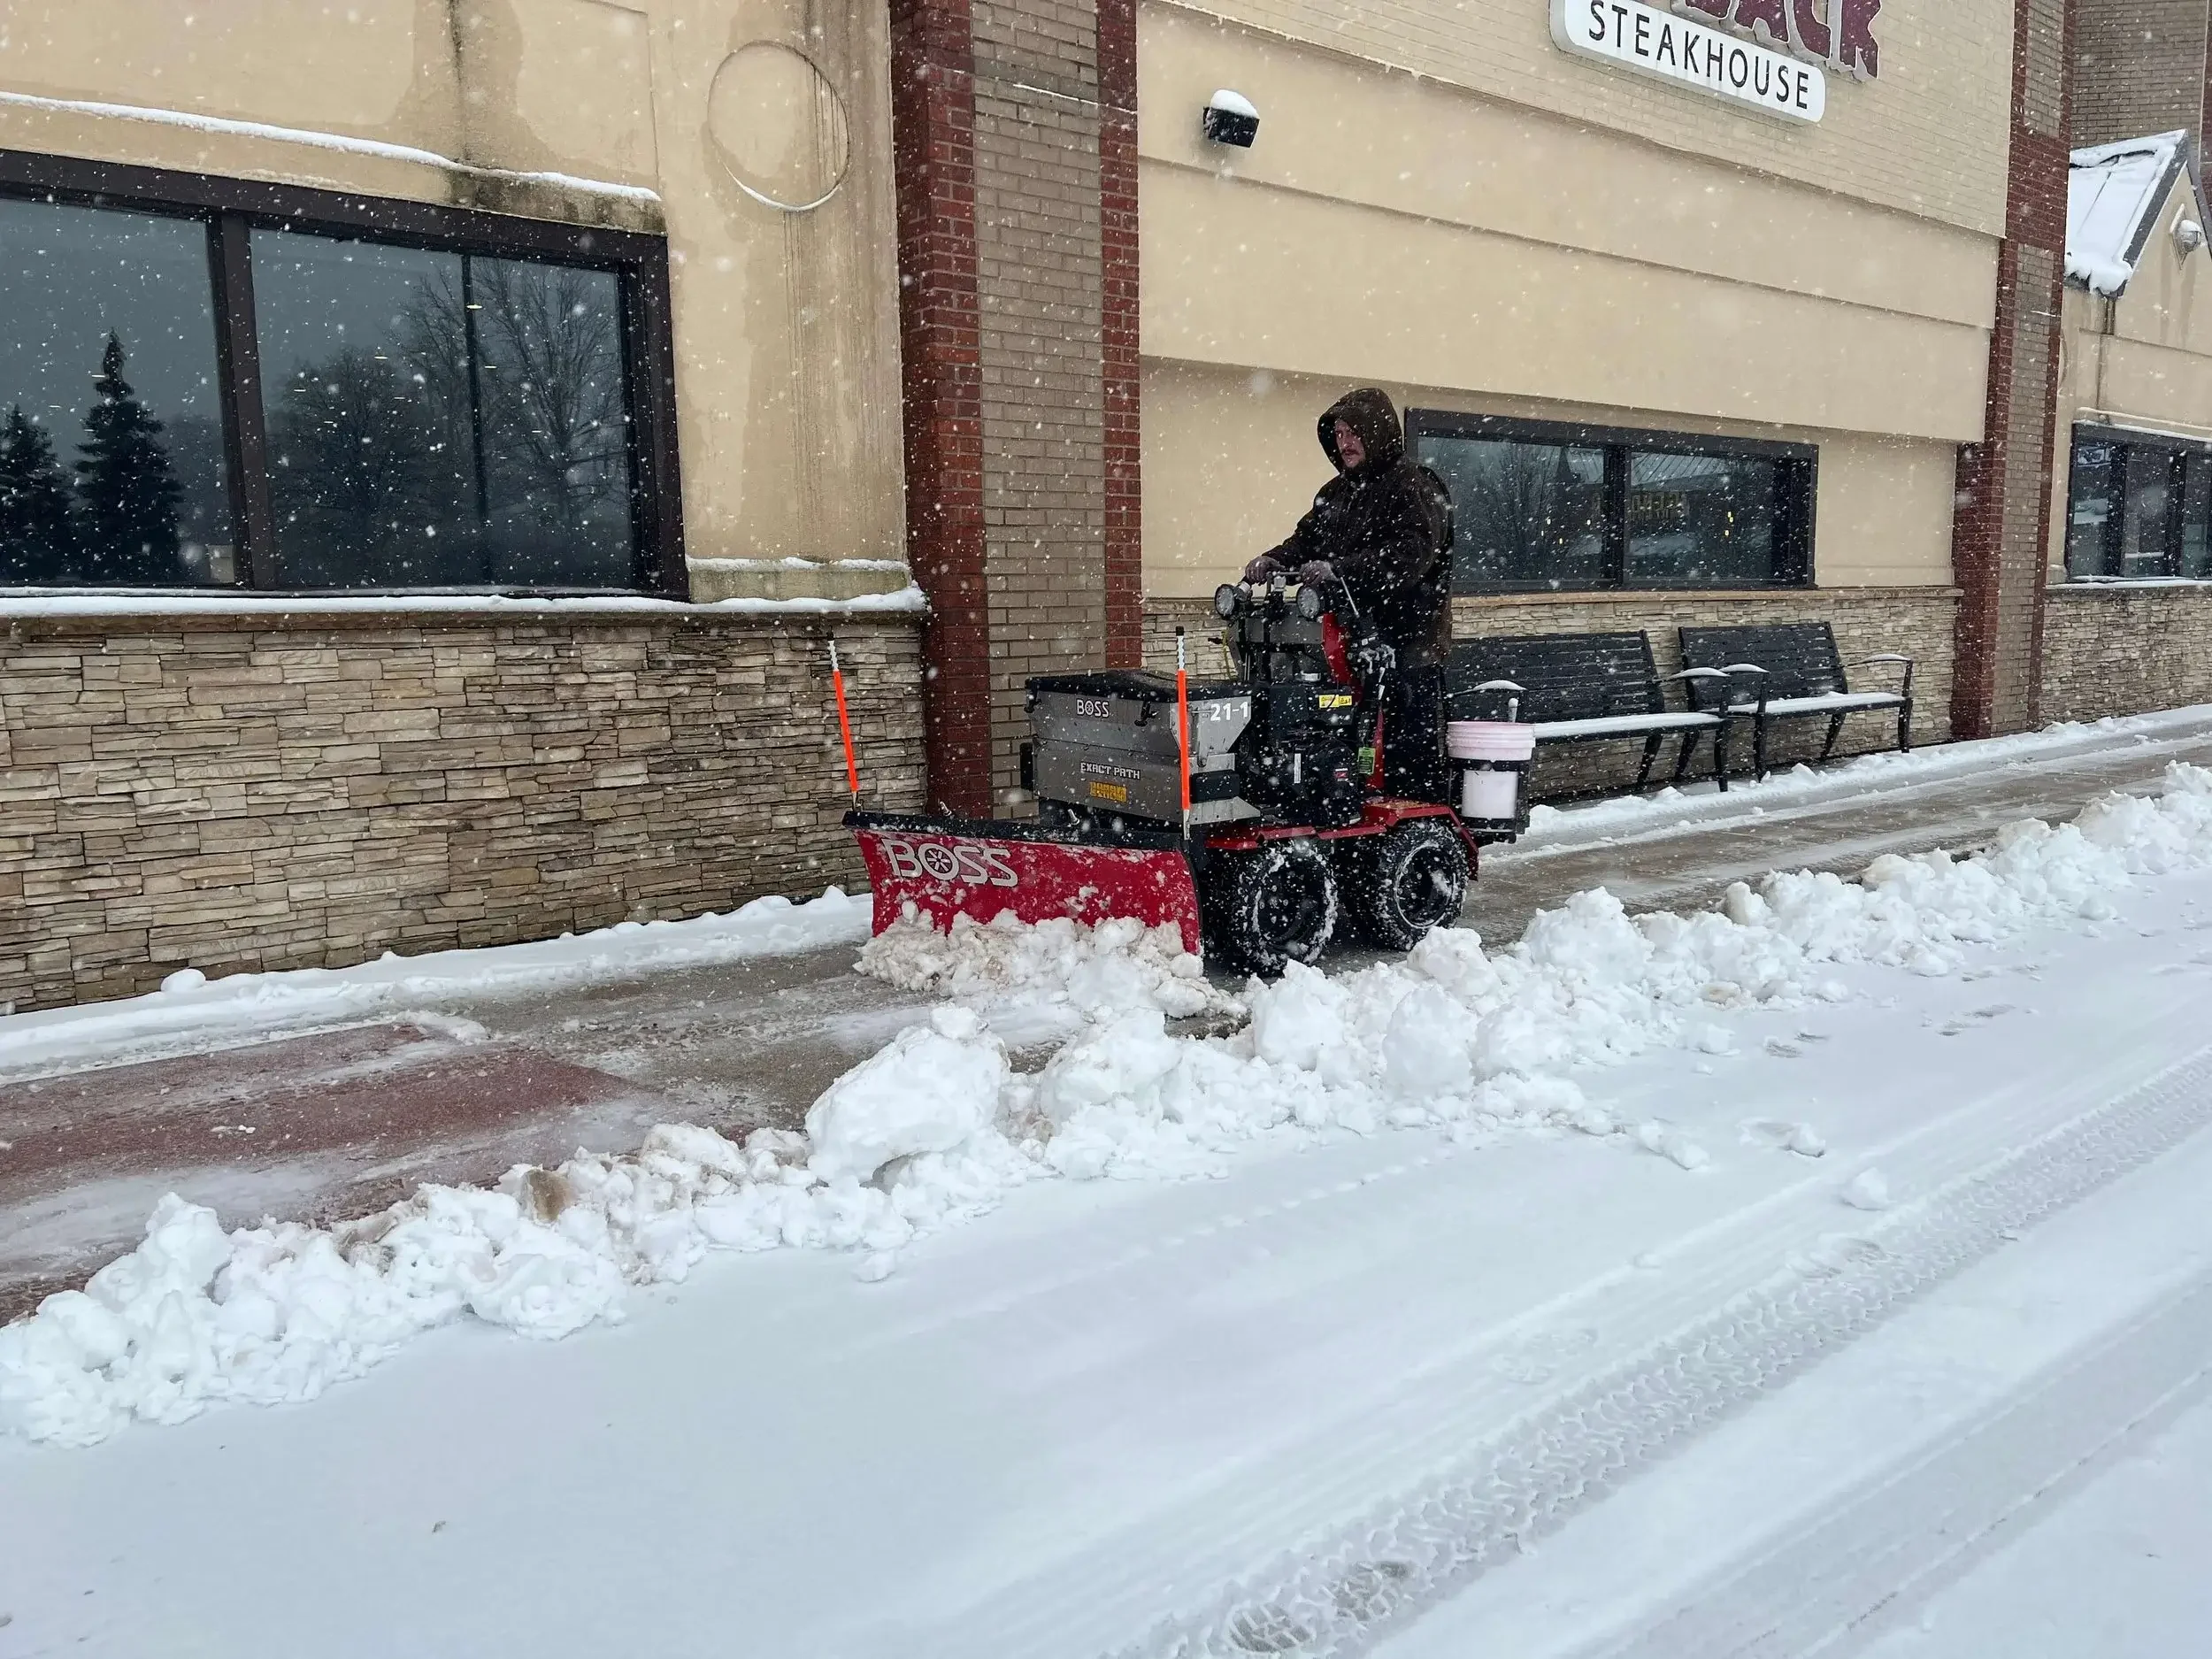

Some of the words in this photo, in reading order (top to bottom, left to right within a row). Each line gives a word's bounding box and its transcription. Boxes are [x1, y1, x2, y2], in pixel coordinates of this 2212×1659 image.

[1589, 2, 1809, 110] STEAKHOUSE
[1077, 699, 1109, 718] BOSS
[1210, 702, 1248, 721] 21-1
[1080, 762, 1111, 775] EXACT
[1113, 767, 1141, 780] PATH
[881, 839, 1018, 887] BOSS
